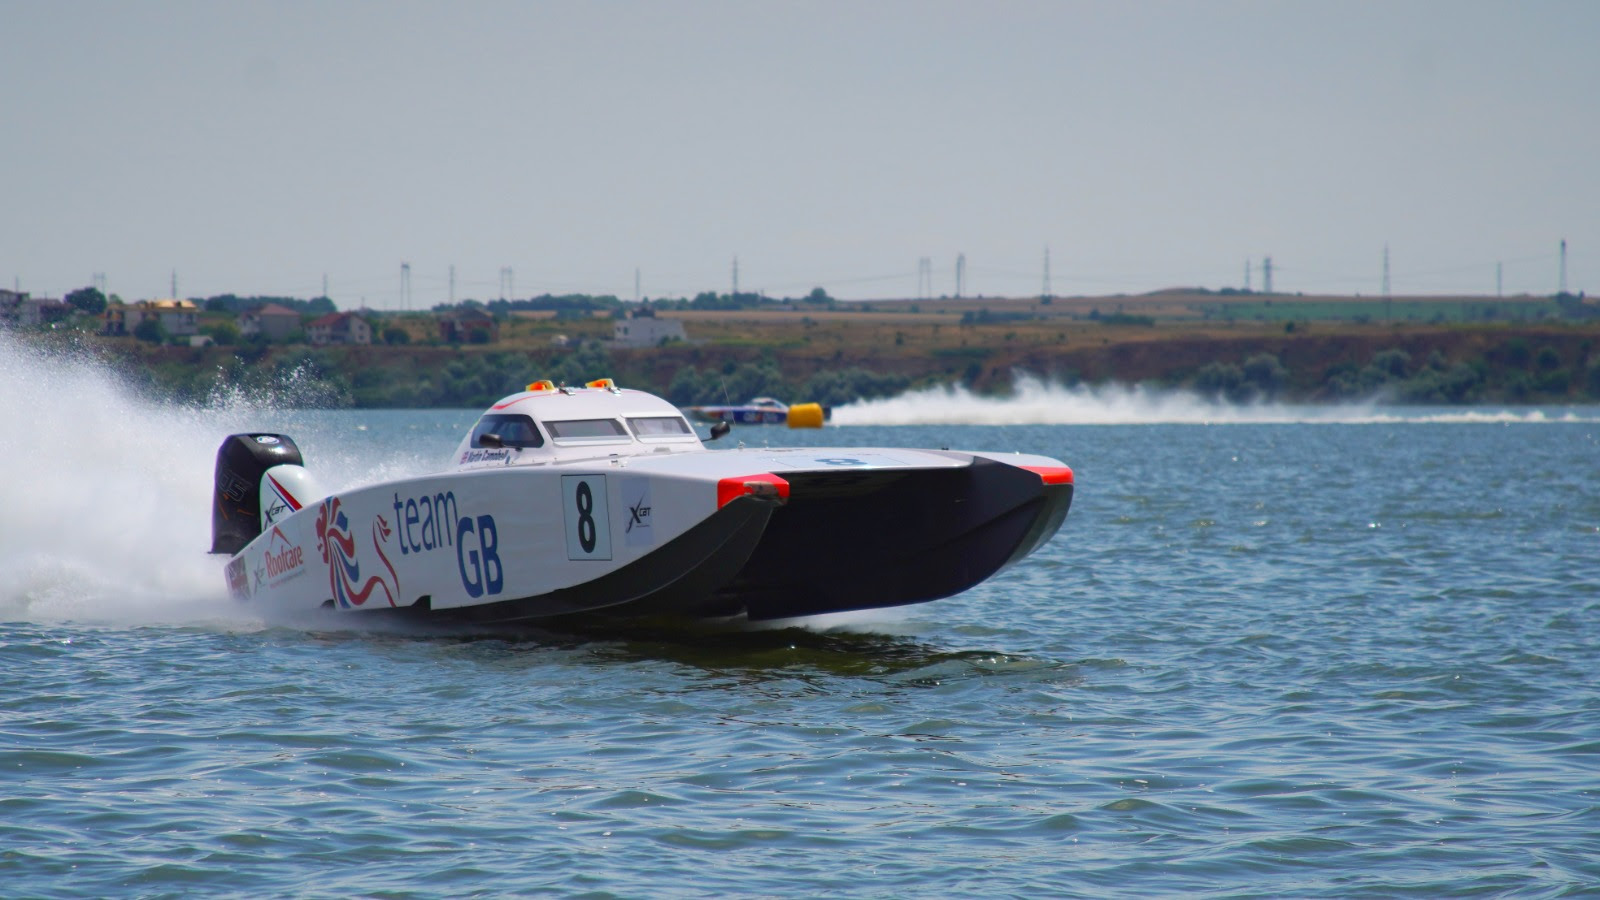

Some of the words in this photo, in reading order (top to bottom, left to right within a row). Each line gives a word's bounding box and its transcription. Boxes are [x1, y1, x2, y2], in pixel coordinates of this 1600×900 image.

[393, 491, 459, 555] team
[456, 514, 504, 598] GB
[576, 481, 596, 553] 8
